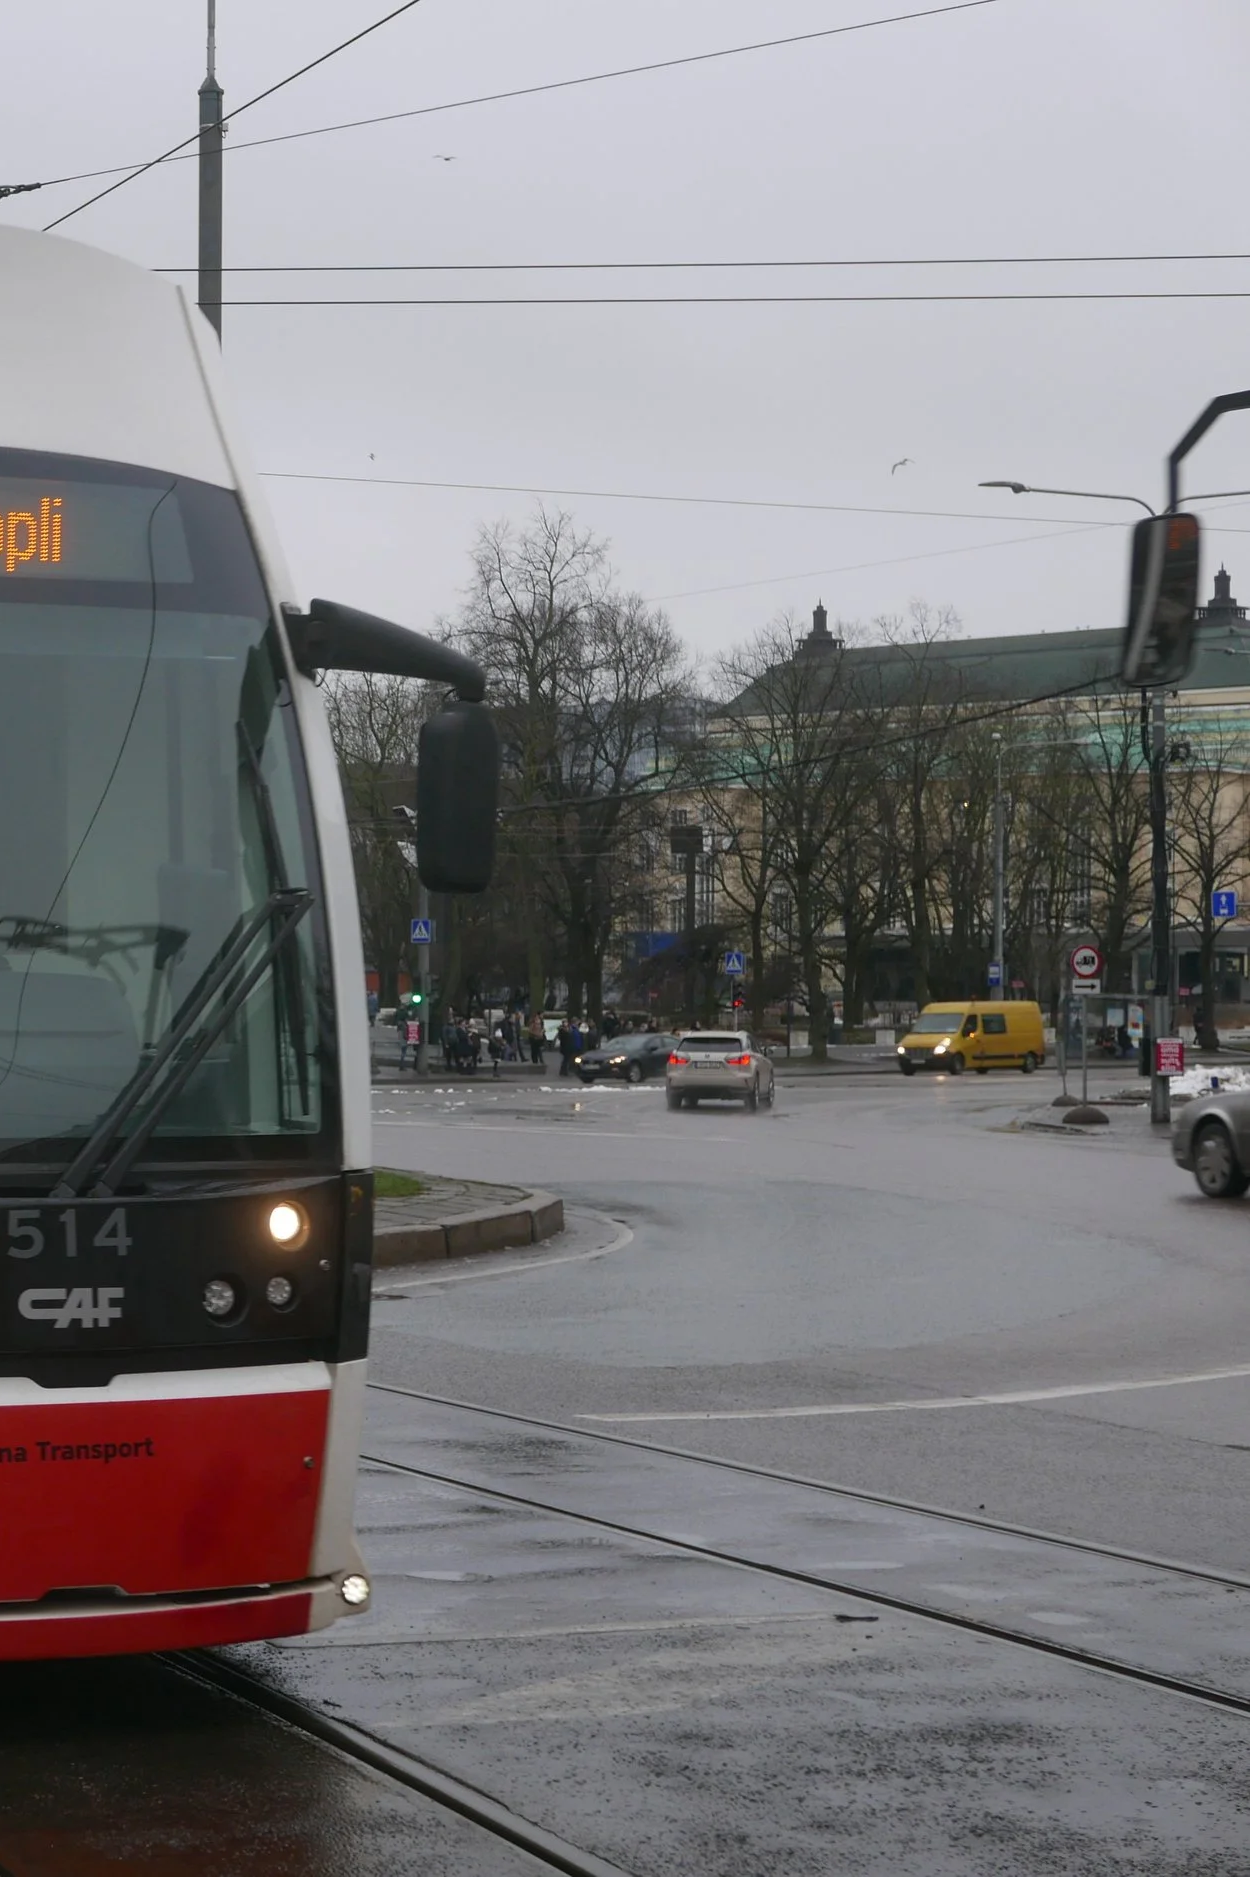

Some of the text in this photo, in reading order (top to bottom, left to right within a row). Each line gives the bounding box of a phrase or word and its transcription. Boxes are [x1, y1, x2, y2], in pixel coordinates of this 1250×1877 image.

[7, 1208, 133, 1259] 514
[17, 1287, 125, 1329] CAF
[37, 1438, 154, 1465] Transport
